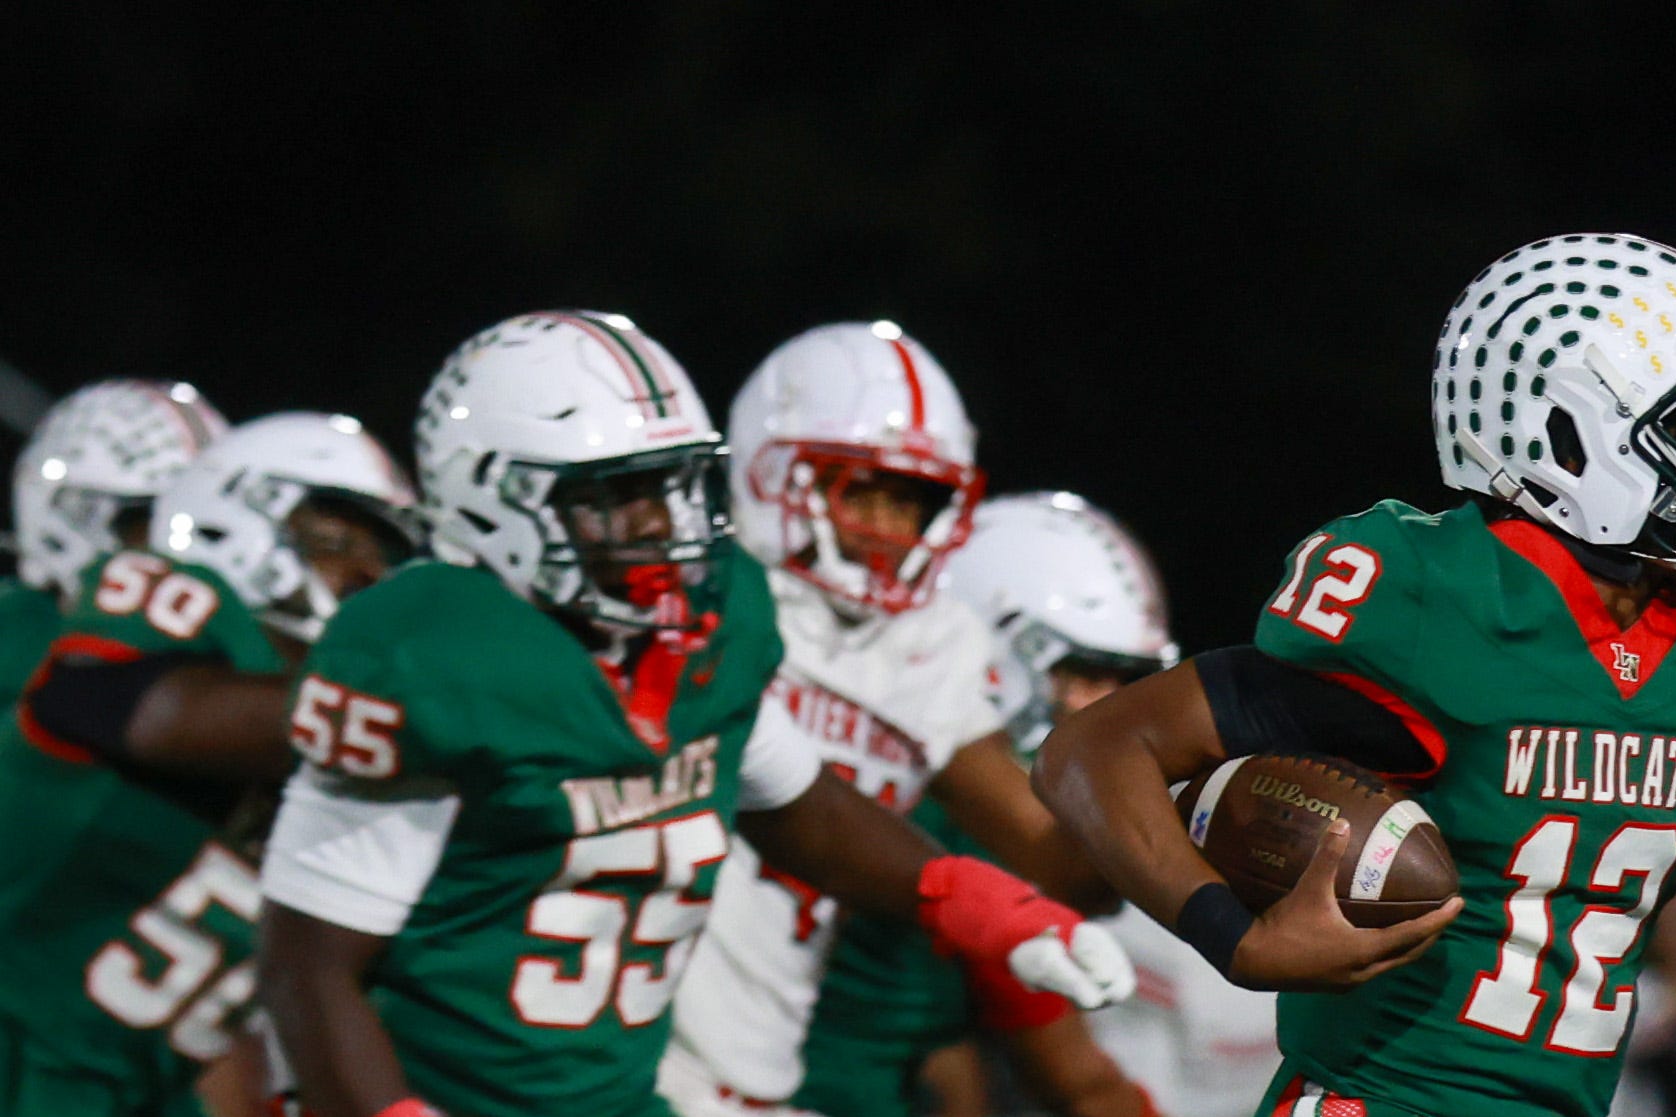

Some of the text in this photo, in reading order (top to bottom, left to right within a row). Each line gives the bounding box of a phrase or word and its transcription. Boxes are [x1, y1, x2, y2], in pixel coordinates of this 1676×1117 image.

[95, 548, 221, 640] 50
[1267, 532, 1383, 644] 12
[290, 674, 406, 780] 55
[1250, 774, 1343, 822] Wilson
[508, 809, 731, 1030] 55
